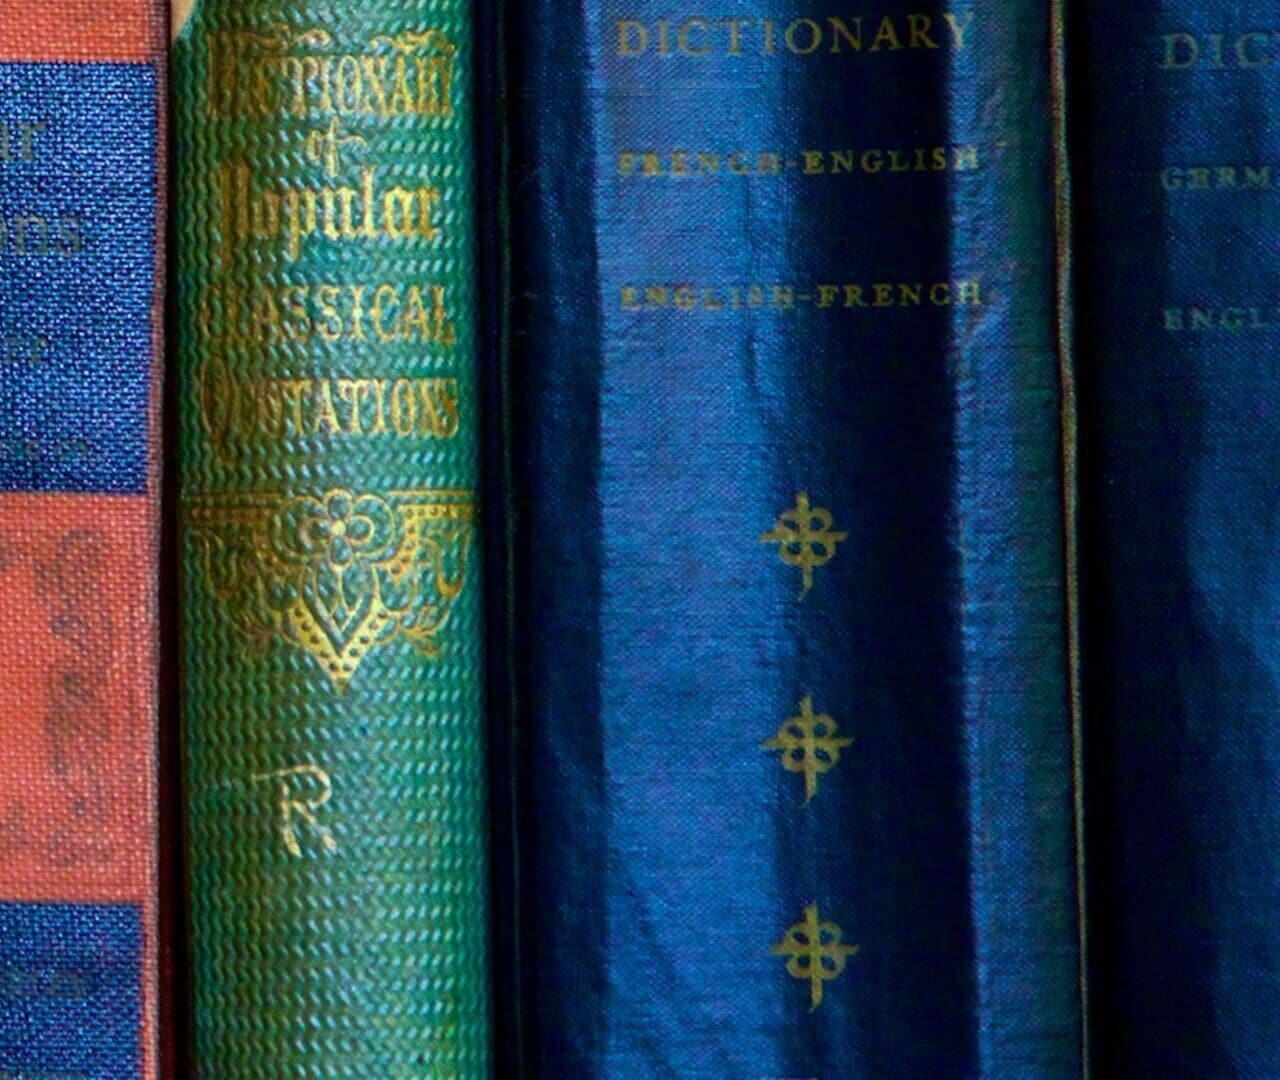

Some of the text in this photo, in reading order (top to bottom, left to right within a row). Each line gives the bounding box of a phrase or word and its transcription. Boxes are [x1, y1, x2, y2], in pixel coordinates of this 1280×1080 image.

[616, 12, 974, 56] DICTIONARY
[618, 148, 981, 178] FRENCH-ENGLISH
[620, 283, 984, 311] ENGLISH-FRENCH
